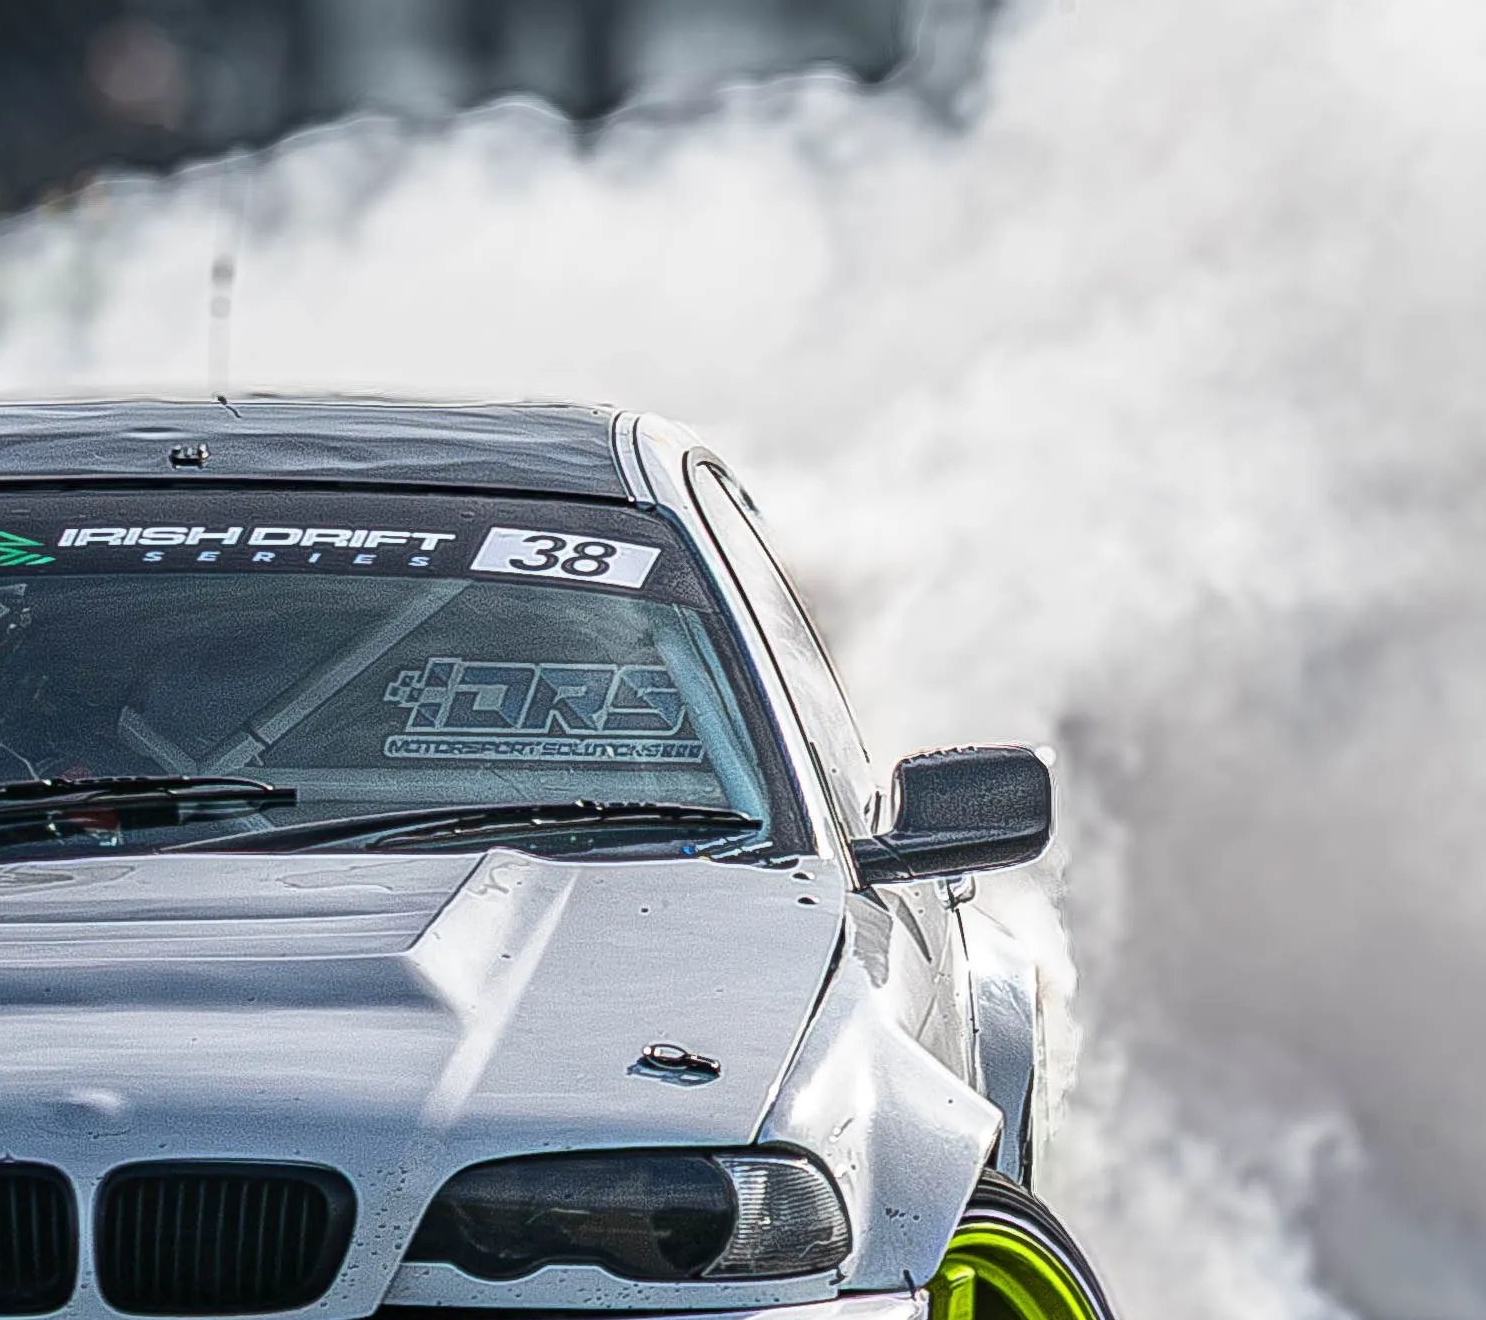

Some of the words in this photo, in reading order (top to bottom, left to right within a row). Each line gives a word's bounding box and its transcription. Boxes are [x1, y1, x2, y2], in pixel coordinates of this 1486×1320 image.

[57, 526, 242, 548] IRISH
[247, 527, 457, 551] DRIFT
[141, 550, 431, 568] SERIES
[507, 533, 619, 578] 38
